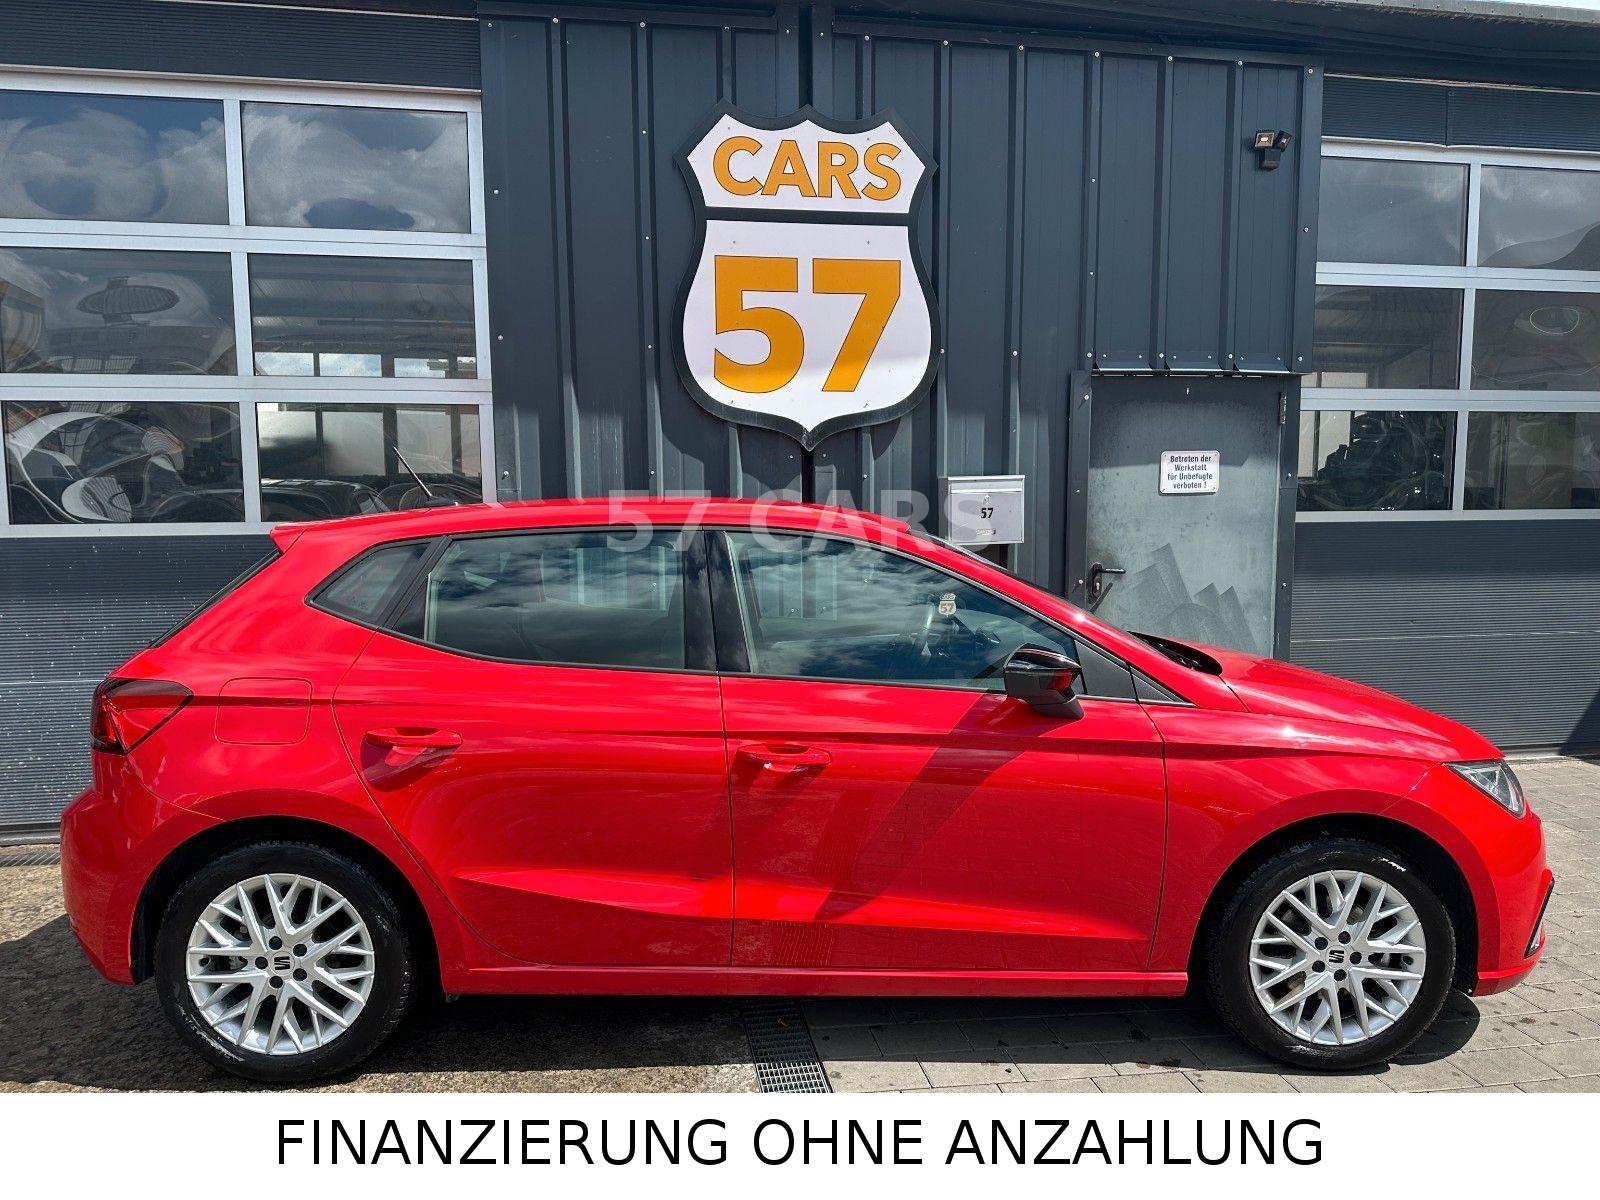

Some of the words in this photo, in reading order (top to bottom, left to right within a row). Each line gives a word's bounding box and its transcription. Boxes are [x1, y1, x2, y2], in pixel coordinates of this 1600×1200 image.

[713, 135, 902, 201] CARS
[714, 255, 902, 393] 57
[1200, 454, 1212, 462] der
[1179, 473, 1213, 481] Unbefugte
[981, 507, 994, 519] 57
[940, 602, 954, 613] 57
